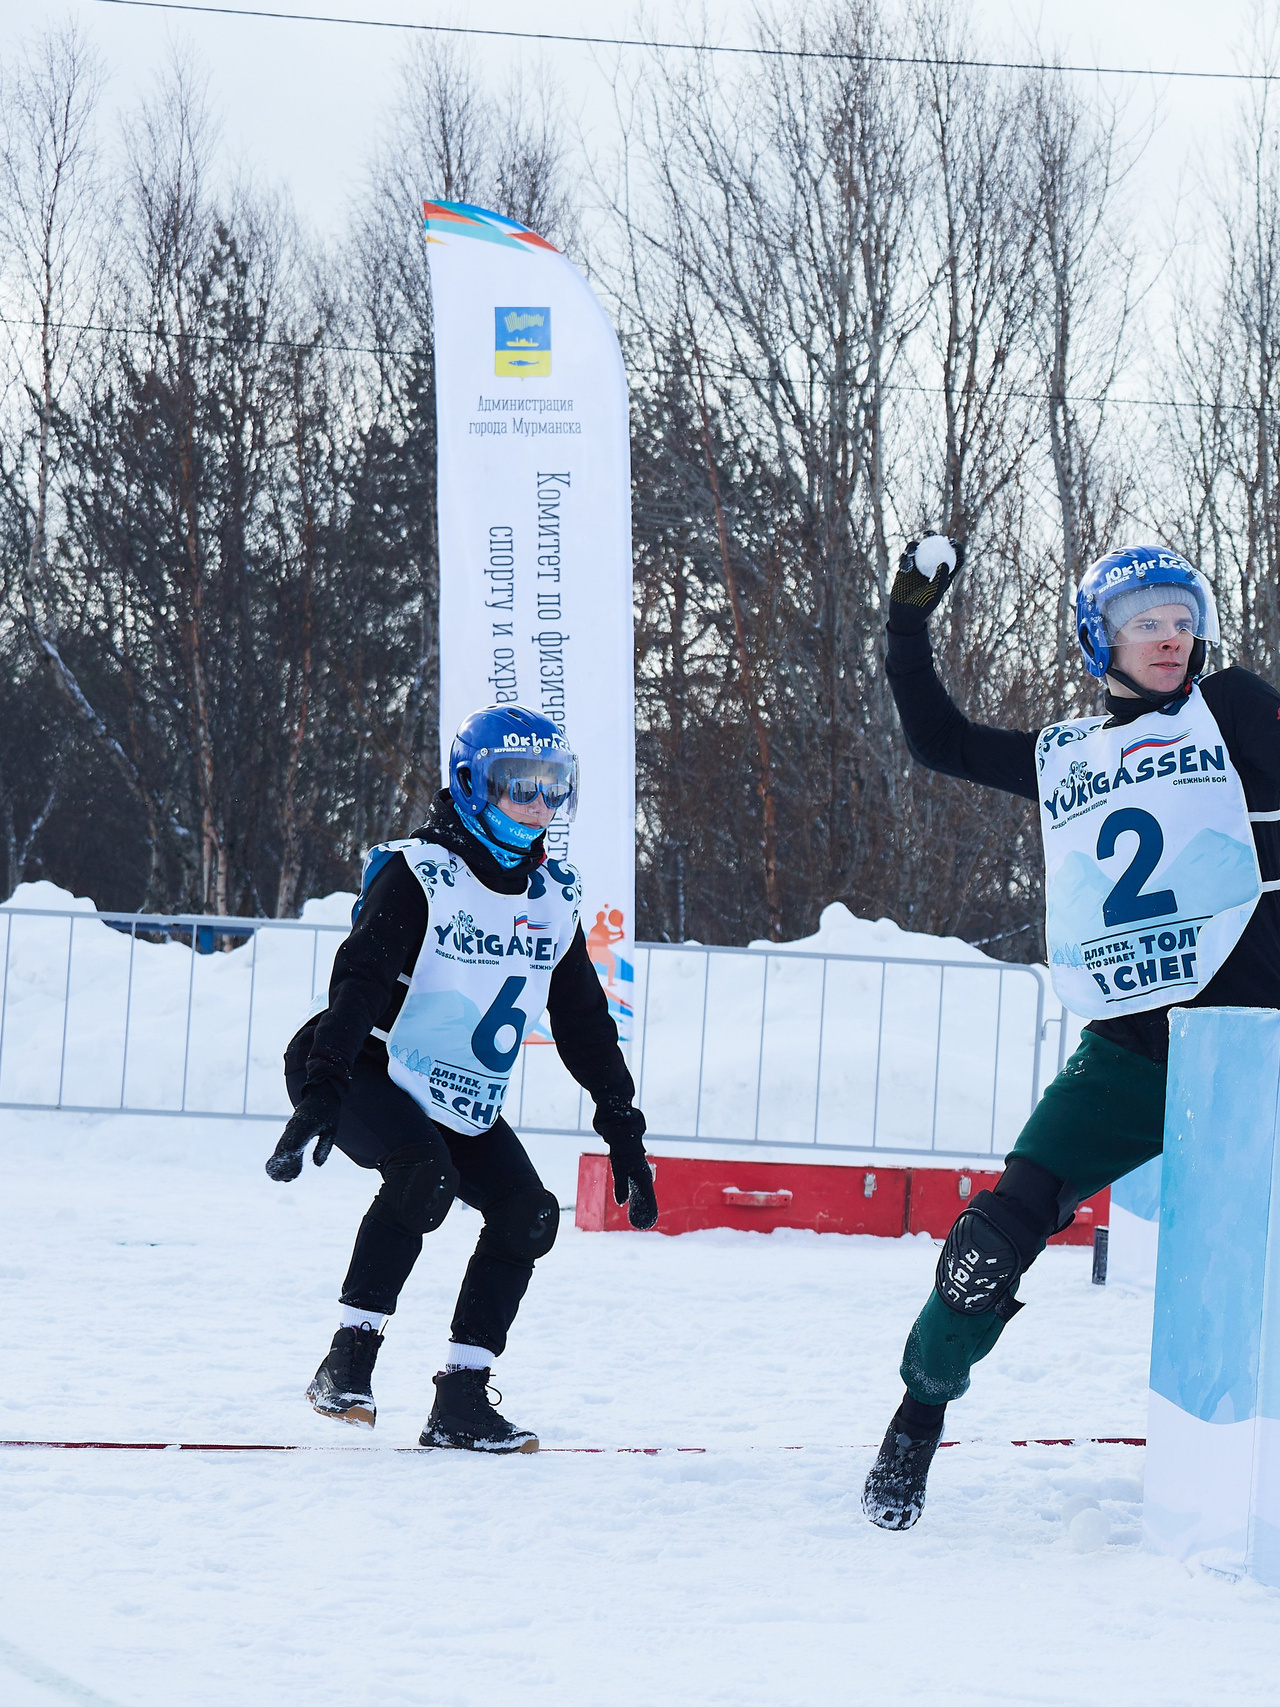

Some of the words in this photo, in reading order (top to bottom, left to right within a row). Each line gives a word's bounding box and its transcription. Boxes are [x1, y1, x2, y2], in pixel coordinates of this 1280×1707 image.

[478, 396, 574, 414] Администрация
[469, 421, 508, 437] города
[512, 418, 582, 437] Мурманска
[537, 471, 571, 582] Комитет
[484, 526, 514, 612] спорту
[537, 593, 562, 620] по
[493, 622, 514, 637] и
[488, 648, 519, 703] охра
[1172, 776, 1210, 786] СНЕЖНЫЙ
[1211, 775, 1227, 783] БОЙ
[1096, 807, 1178, 928] 2
[1084, 947, 1105, 961] ДЛЯ
[1105, 940, 1134, 954] ТЕХ,
[1138, 926, 1202, 955] ТОЛ
[1086, 961, 1102, 970] КТО
[1103, 951, 1136, 966] ЗНАЕТ
[1092, 972, 1111, 995] В
[1113, 952, 1197, 991] СНЕГ
[471, 975, 527, 1073] 6
[429, 1076, 449, 1088] КТО
[449, 1082, 480, 1097] ЗНАЕТ
[431, 1067, 457, 1081] ДЛЯ
[458, 1074, 482, 1090] ТЕХ,
[429, 1085, 447, 1104] В
[451, 1096, 502, 1125] СН
